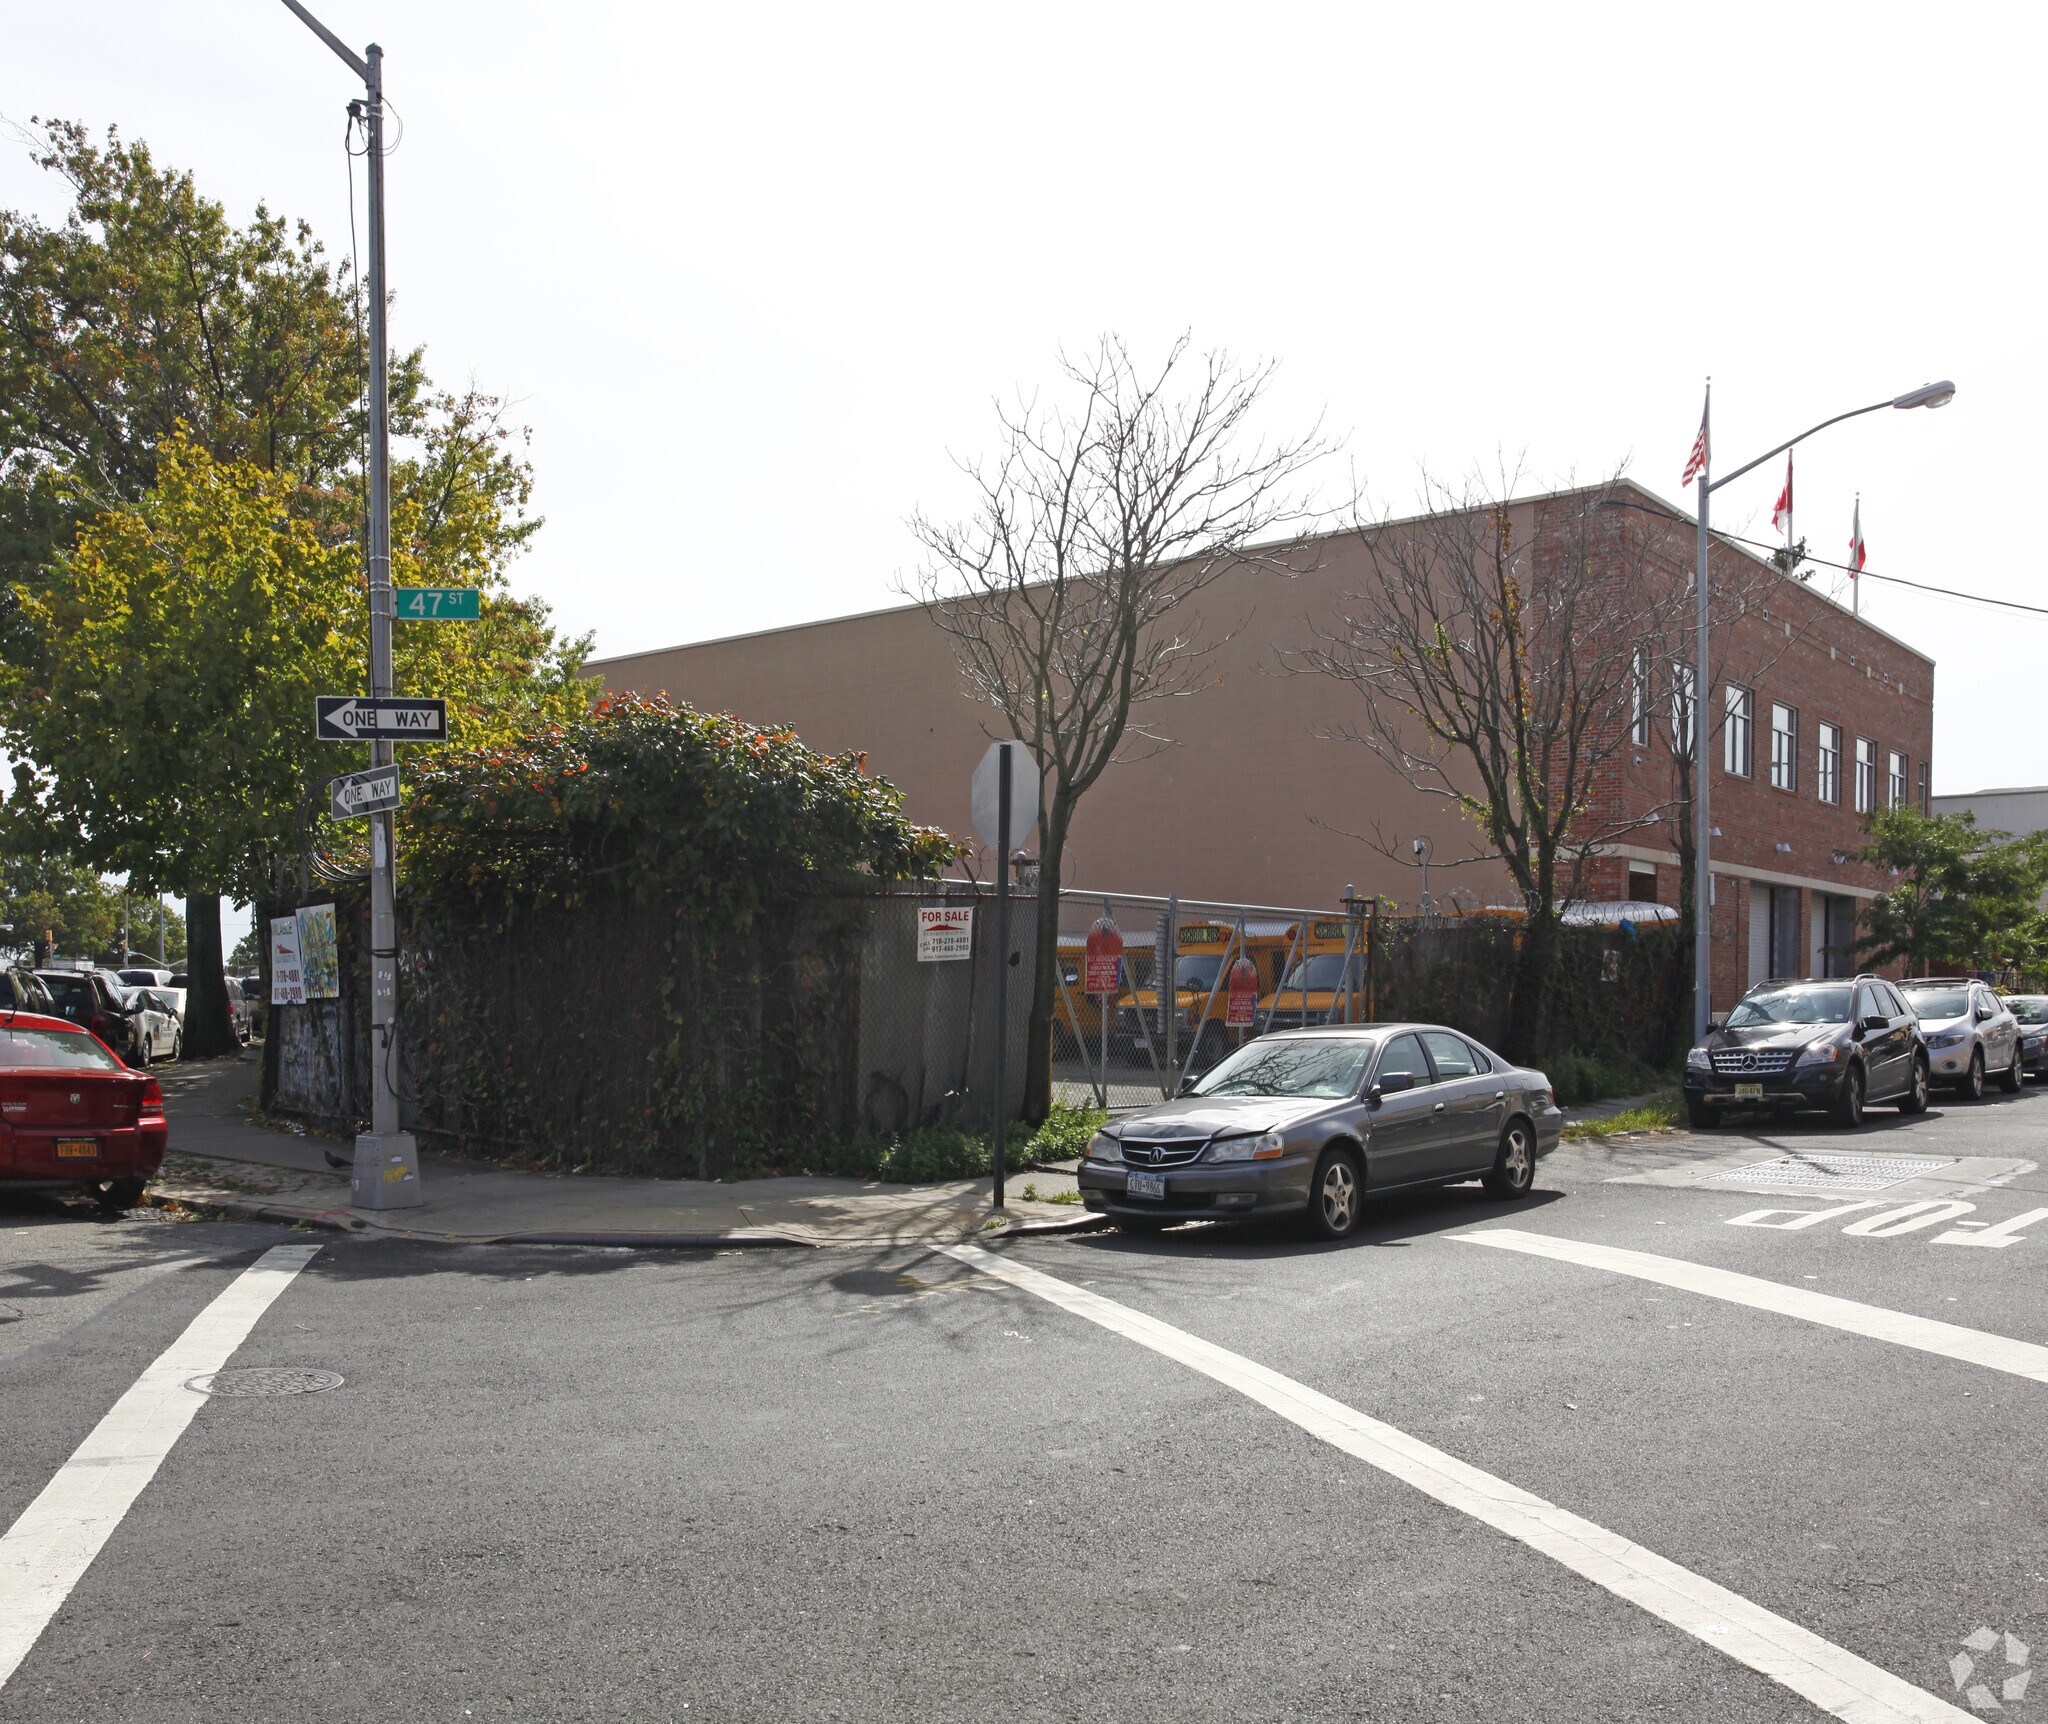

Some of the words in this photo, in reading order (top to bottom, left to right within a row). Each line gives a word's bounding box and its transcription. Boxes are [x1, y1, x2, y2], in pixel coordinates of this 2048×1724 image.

[408, 592, 443, 616] 47
[448, 592, 464, 605] ST
[343, 710, 376, 727] ONE
[395, 711, 432, 728] WAY
[344, 786, 363, 804] ONE
[371, 779, 392, 799] WAY
[922, 911, 942, 922] FOR
[944, 911, 970, 921] SALE
[920, 940, 931, 948] CALL
